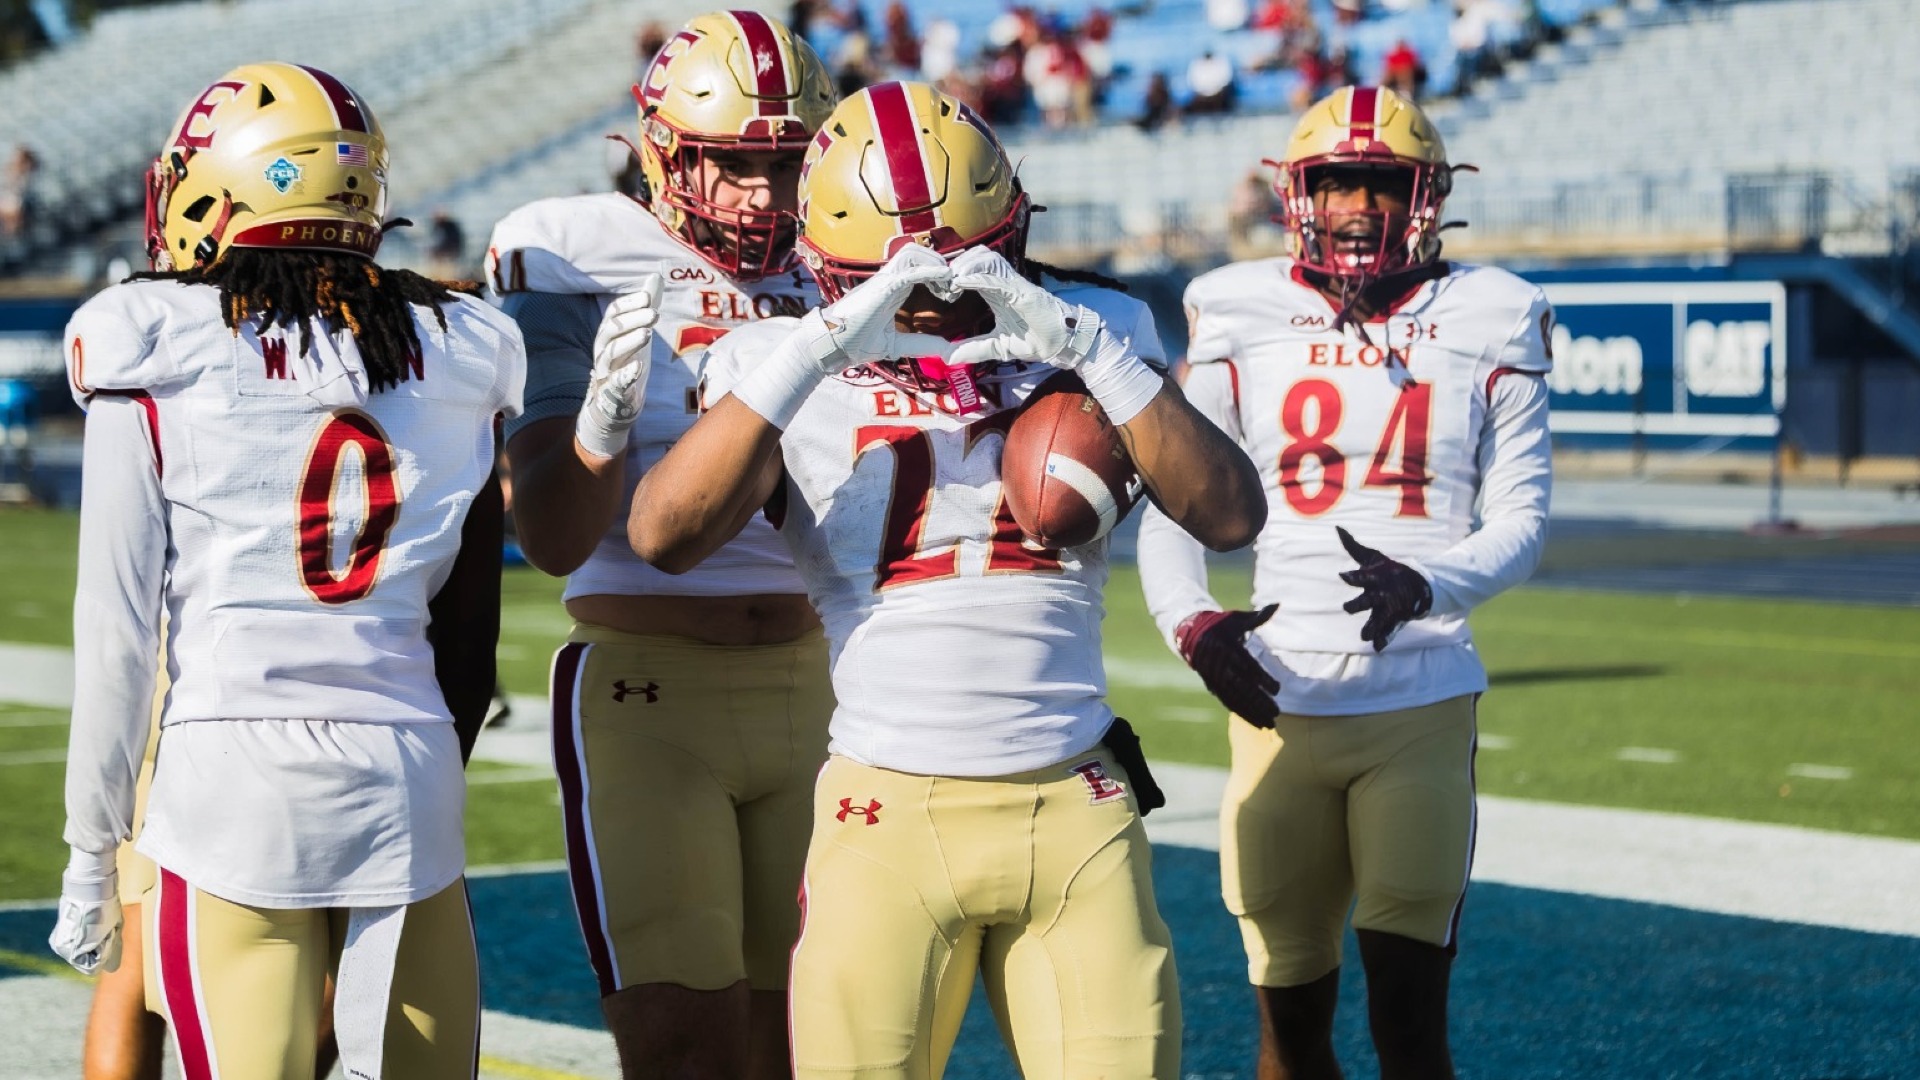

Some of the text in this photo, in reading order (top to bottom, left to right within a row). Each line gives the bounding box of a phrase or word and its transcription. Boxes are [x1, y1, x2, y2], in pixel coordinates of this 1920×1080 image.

[281, 226, 378, 247] PHOENI
[670, 268, 707, 280] CAA
[1307, 343, 1412, 368] ELON
[1279, 376, 1434, 518] 84
[293, 408, 402, 607] 0
[1069, 758, 1127, 804] E
